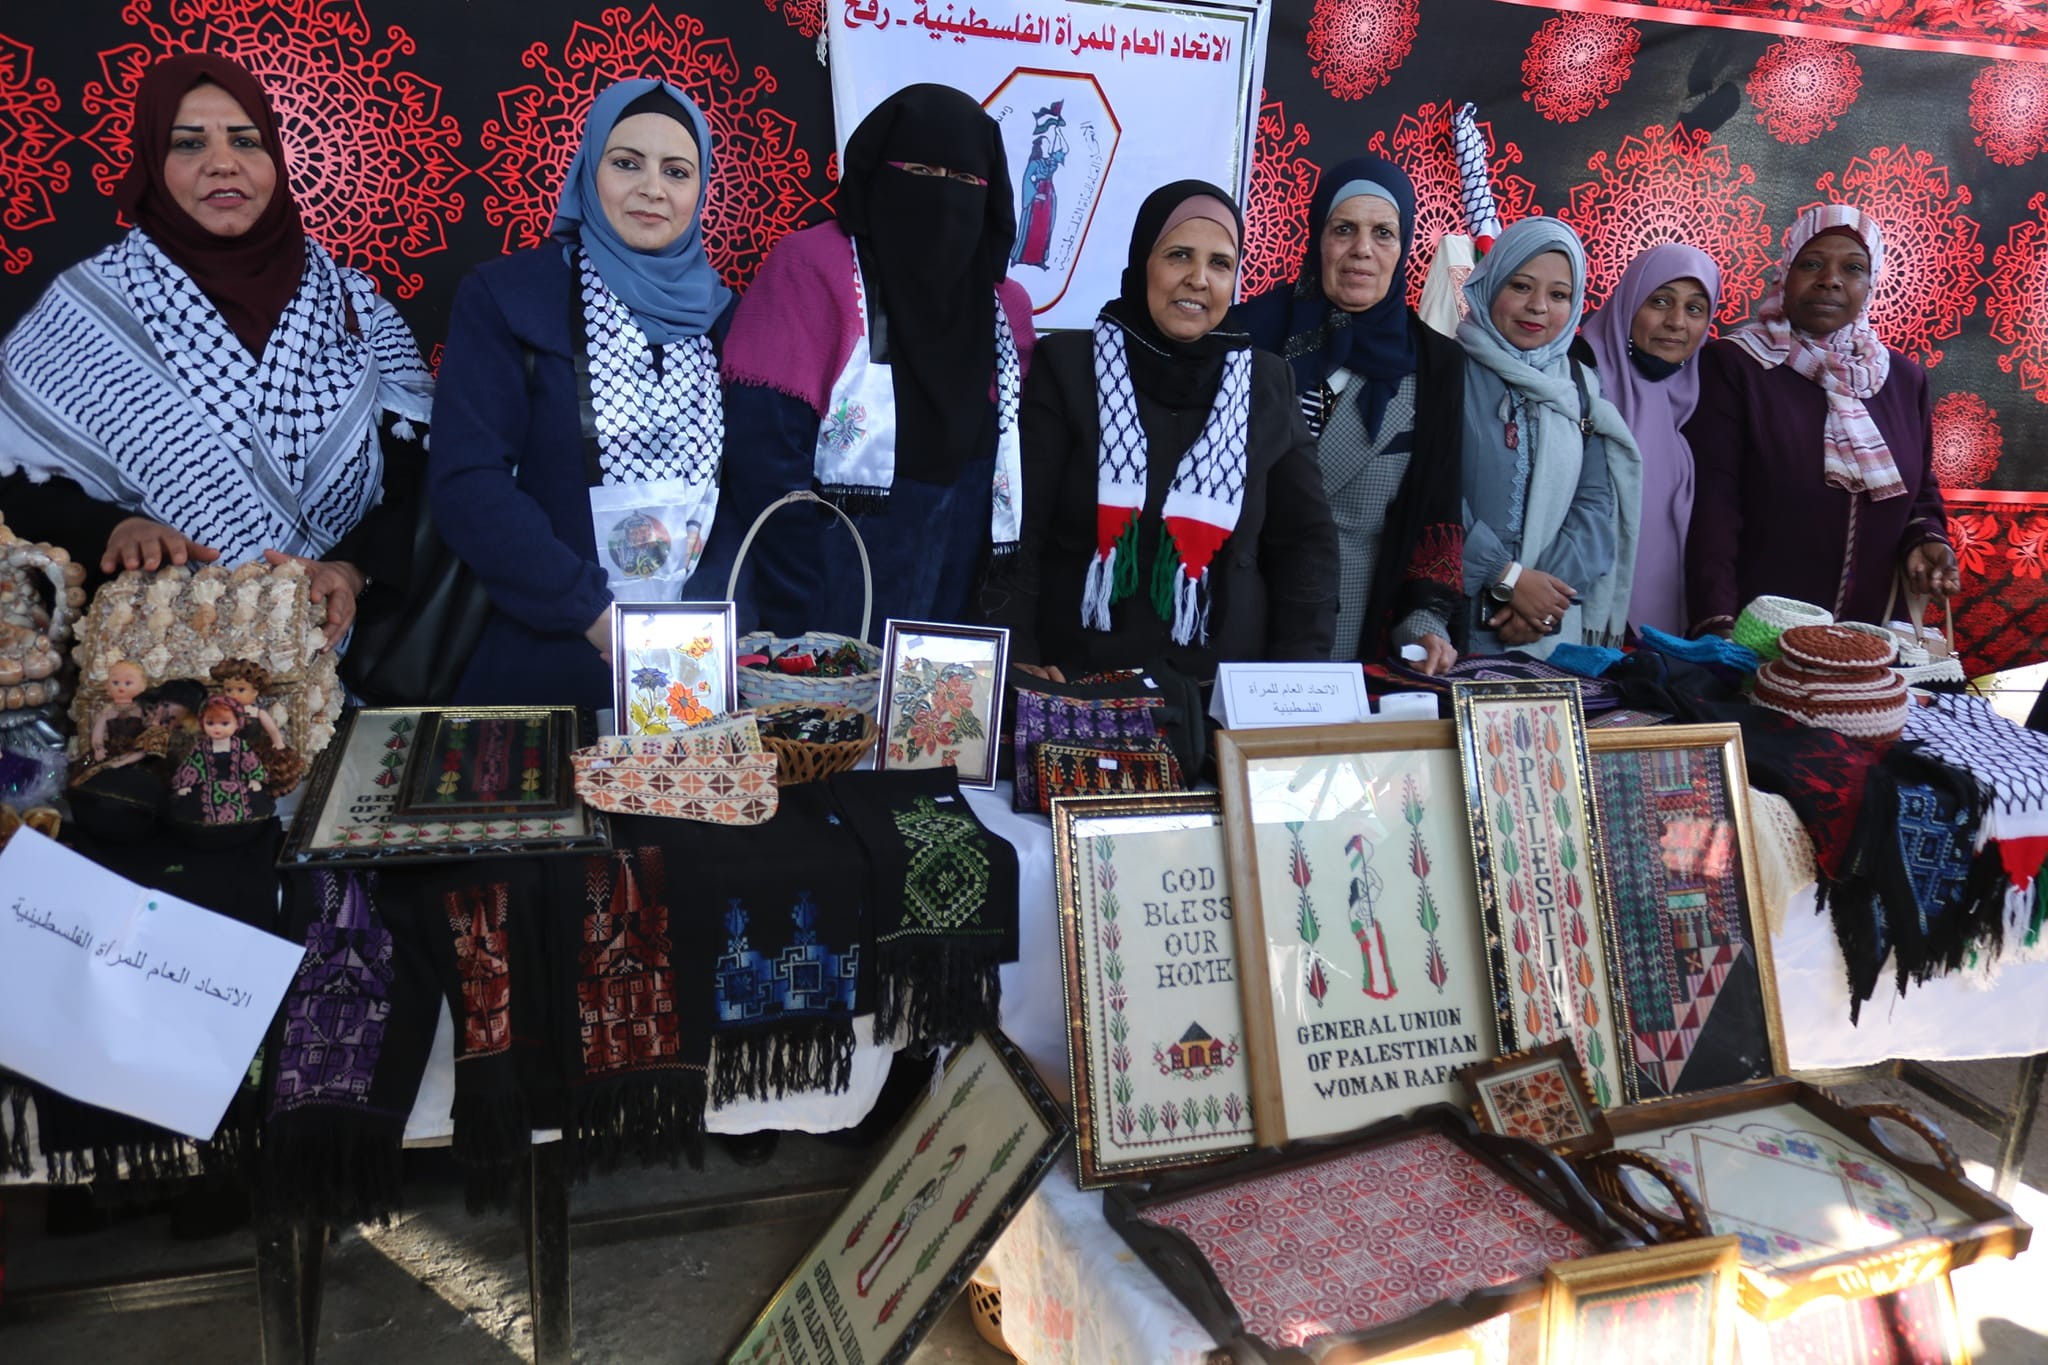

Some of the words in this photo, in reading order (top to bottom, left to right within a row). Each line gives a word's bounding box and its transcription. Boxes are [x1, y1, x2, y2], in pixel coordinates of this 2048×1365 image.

[913, 0, 1050, 44] الفلسطينية
[1055, 13, 1116, 56] للمرأة
[1121, 26, 1164, 62] العام
[1170, 32, 1231, 62] الاتحاد
[1282, 682, 1303, 695] العام
[1307, 683, 1339, 696] الاتحاد
[1273, 701, 1322, 716] الفلسطينية
[1161, 866, 1215, 893] GOD
[11, 896, 94, 950] الفلسطينية
[1143, 896, 1233, 927] BLESS
[1165, 930, 1219, 957] OUR
[146, 961, 191, 985] العام
[1155, 958, 1235, 989] HOME
[194, 977, 252, 1008] الاتحاد
[1297, 1015, 1397, 1045] GENERAL
[1399, 1008, 1462, 1032] UNION
[1307, 1051, 1333, 1072] OF
[1337, 1034, 1479, 1068] PALESTINIAN
[1314, 1071, 1400, 1100] WOMAN
[796, 1281, 812, 1305] OF
[814, 1259, 848, 1333] GENERAL
